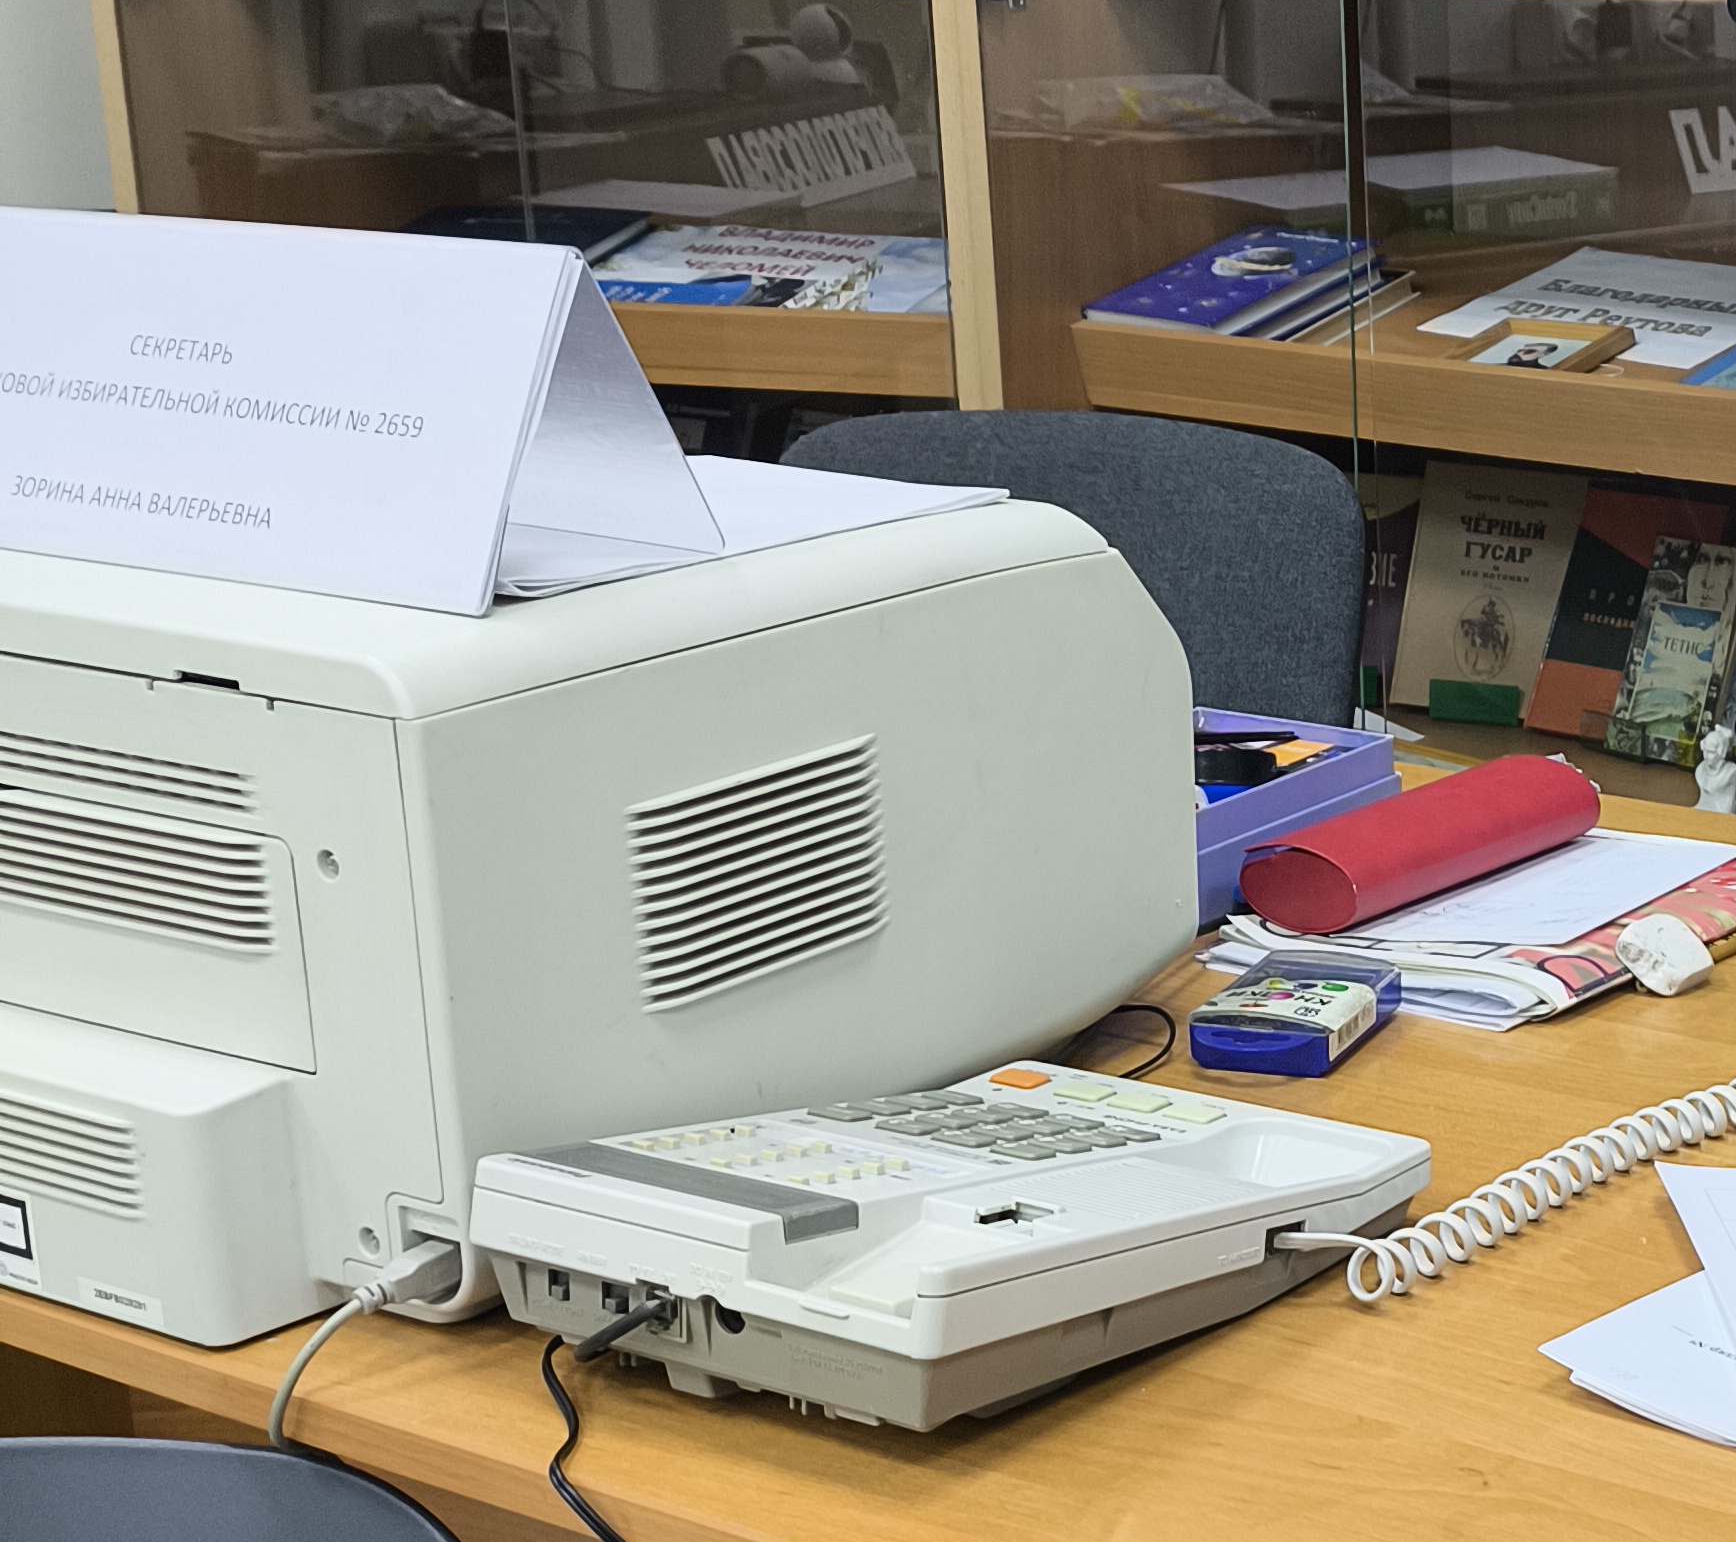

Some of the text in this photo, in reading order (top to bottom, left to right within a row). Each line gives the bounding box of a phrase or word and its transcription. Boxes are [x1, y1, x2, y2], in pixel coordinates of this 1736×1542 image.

[1577, 307, 1713, 337] Реутова
[129, 334, 234, 365] СЕКРЕТАРЬ
[57, 377, 220, 417] ИЗБИРАТЕЛЬНОЙ
[222, 395, 341, 430] КОМИССИИ
[345, 409, 369, 433] №
[374, 412, 425, 438] 2659
[10, 474, 272, 529] ЗОРИНА АННА ВАЛЕРЬЕВНА
[1460, 511, 1548, 541] ЧЁРНЫЙ
[1463, 540, 1534, 564] ГУСАР
[1663, 635, 1703, 655] ТЕТИС
